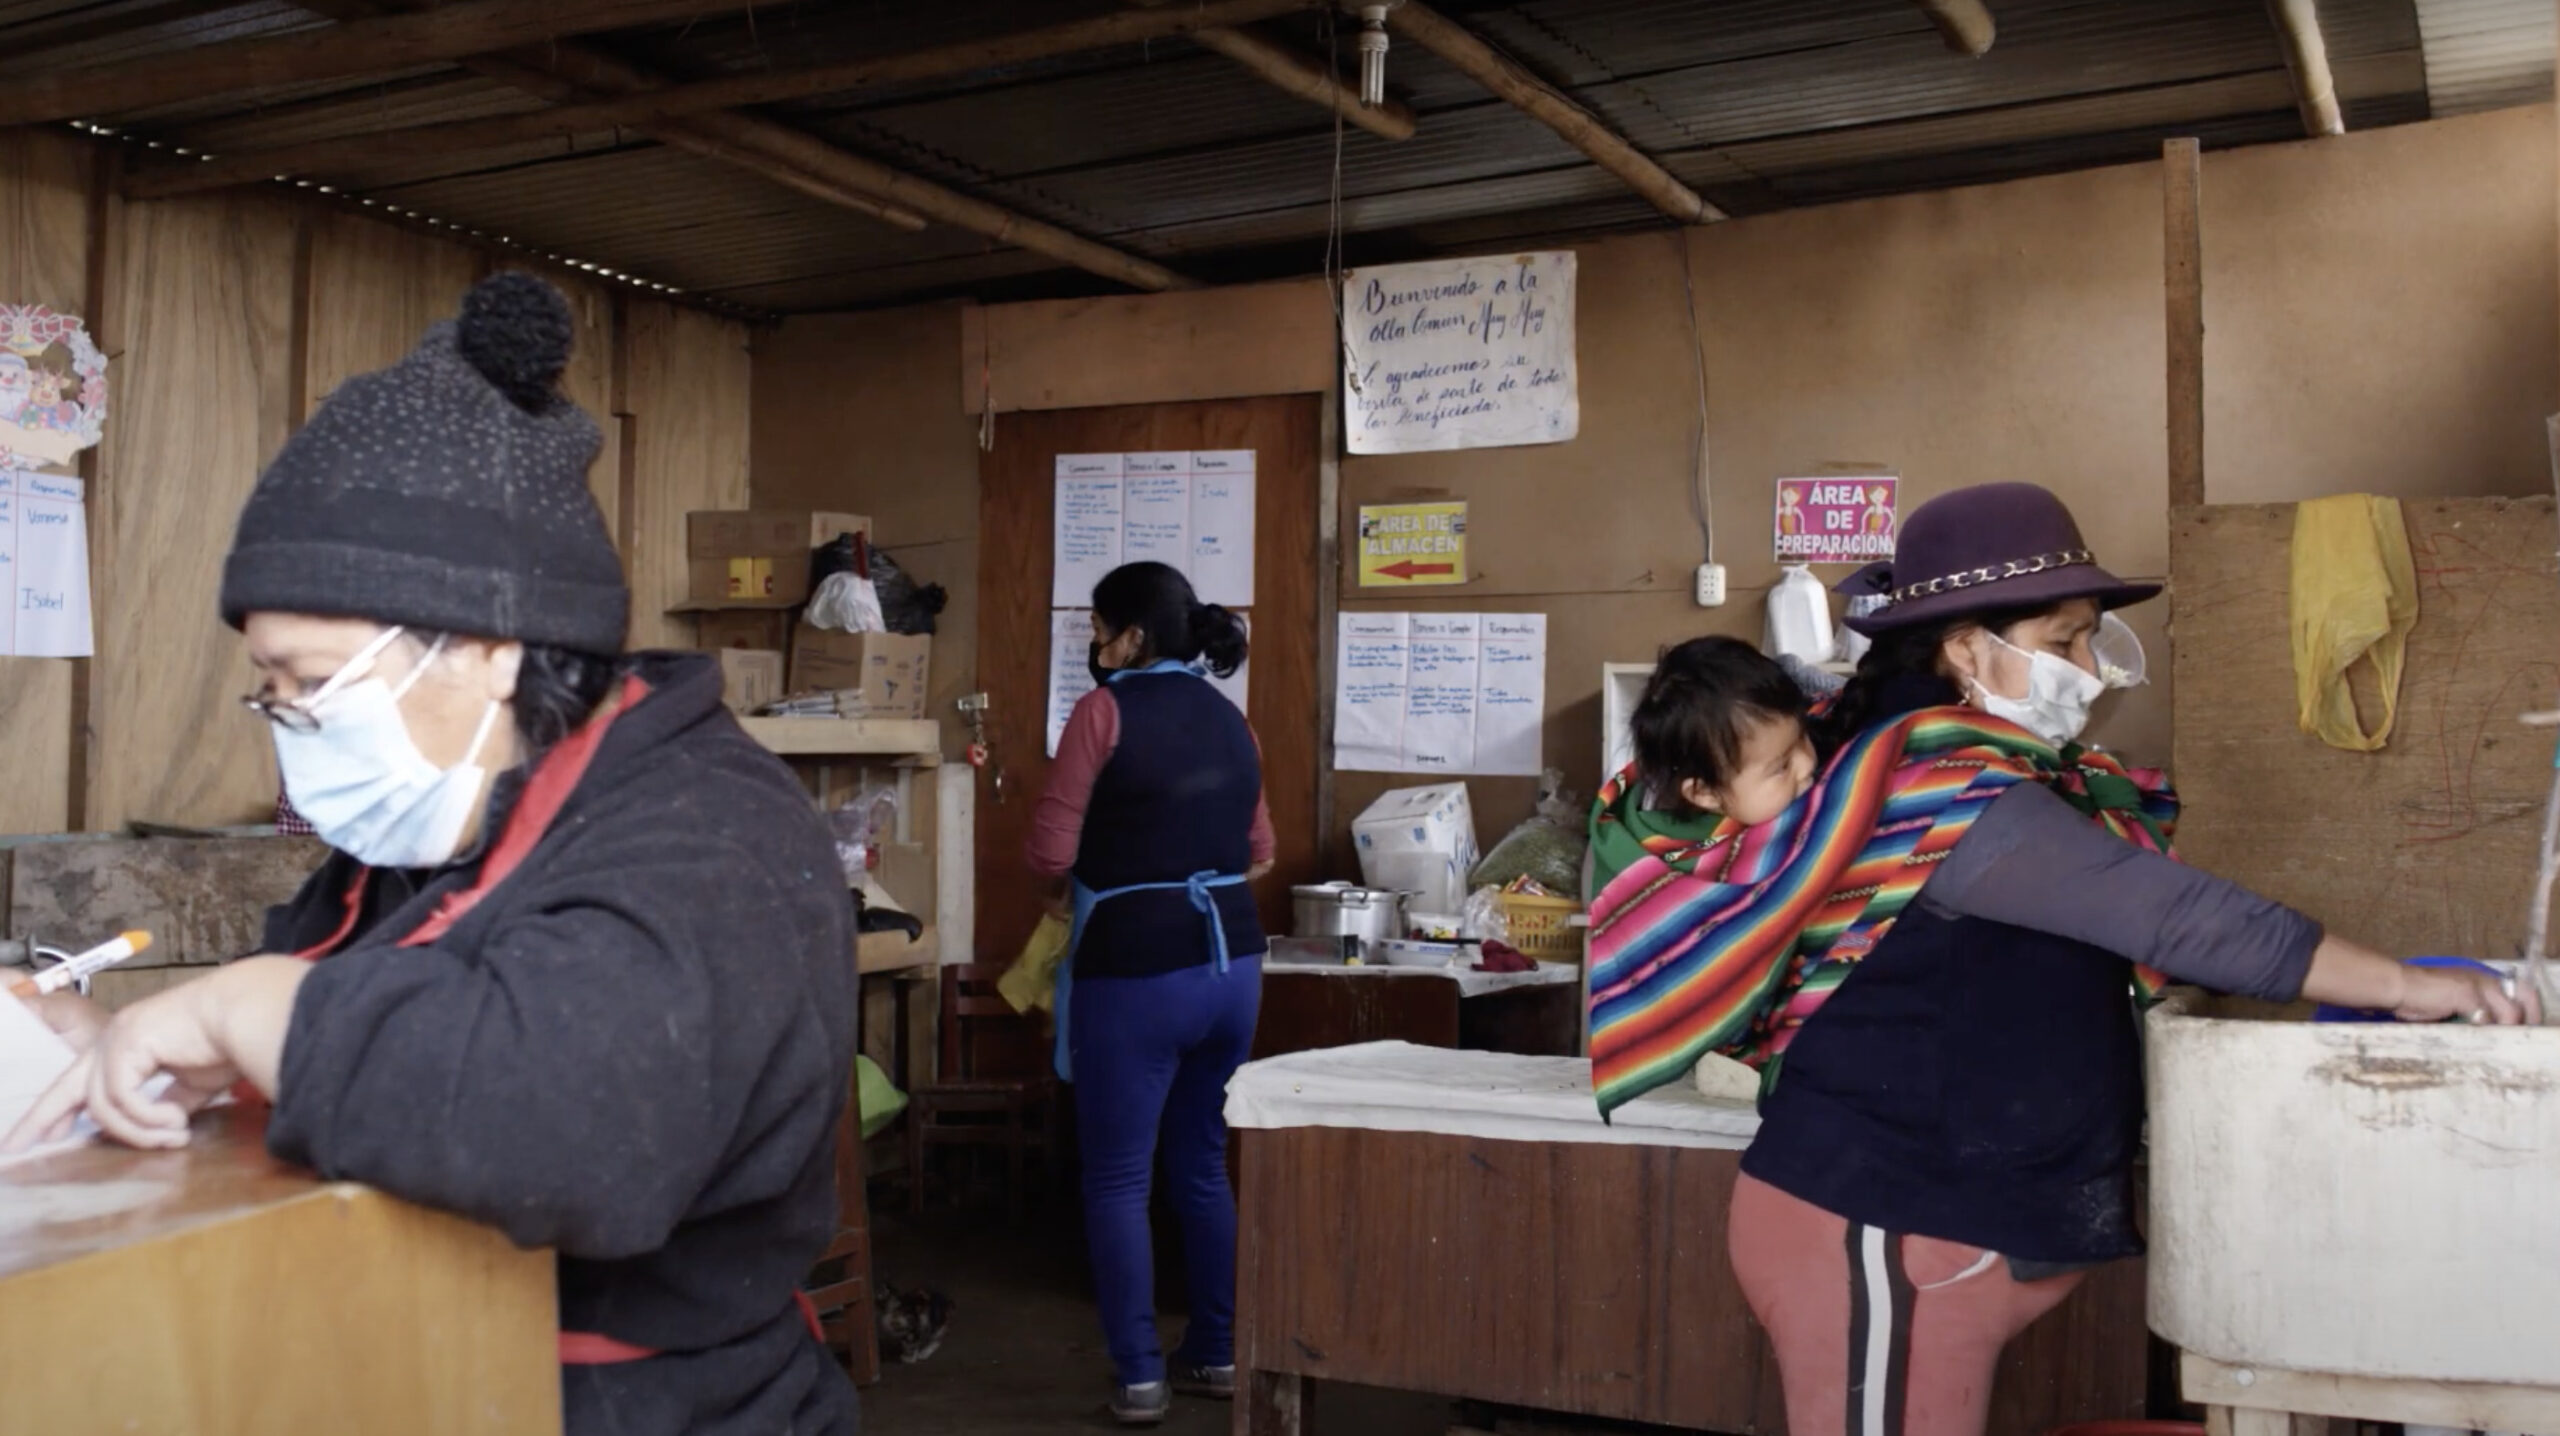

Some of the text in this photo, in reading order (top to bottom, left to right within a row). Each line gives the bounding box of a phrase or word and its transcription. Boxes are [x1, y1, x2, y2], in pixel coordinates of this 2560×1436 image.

[1495, 279, 1507, 295] a
[1809, 481, 1866, 505] ÁREA
[1424, 513, 1450, 531] DE
[1826, 509, 1853, 530] DE
[21, 587, 64, 610] Isabel
